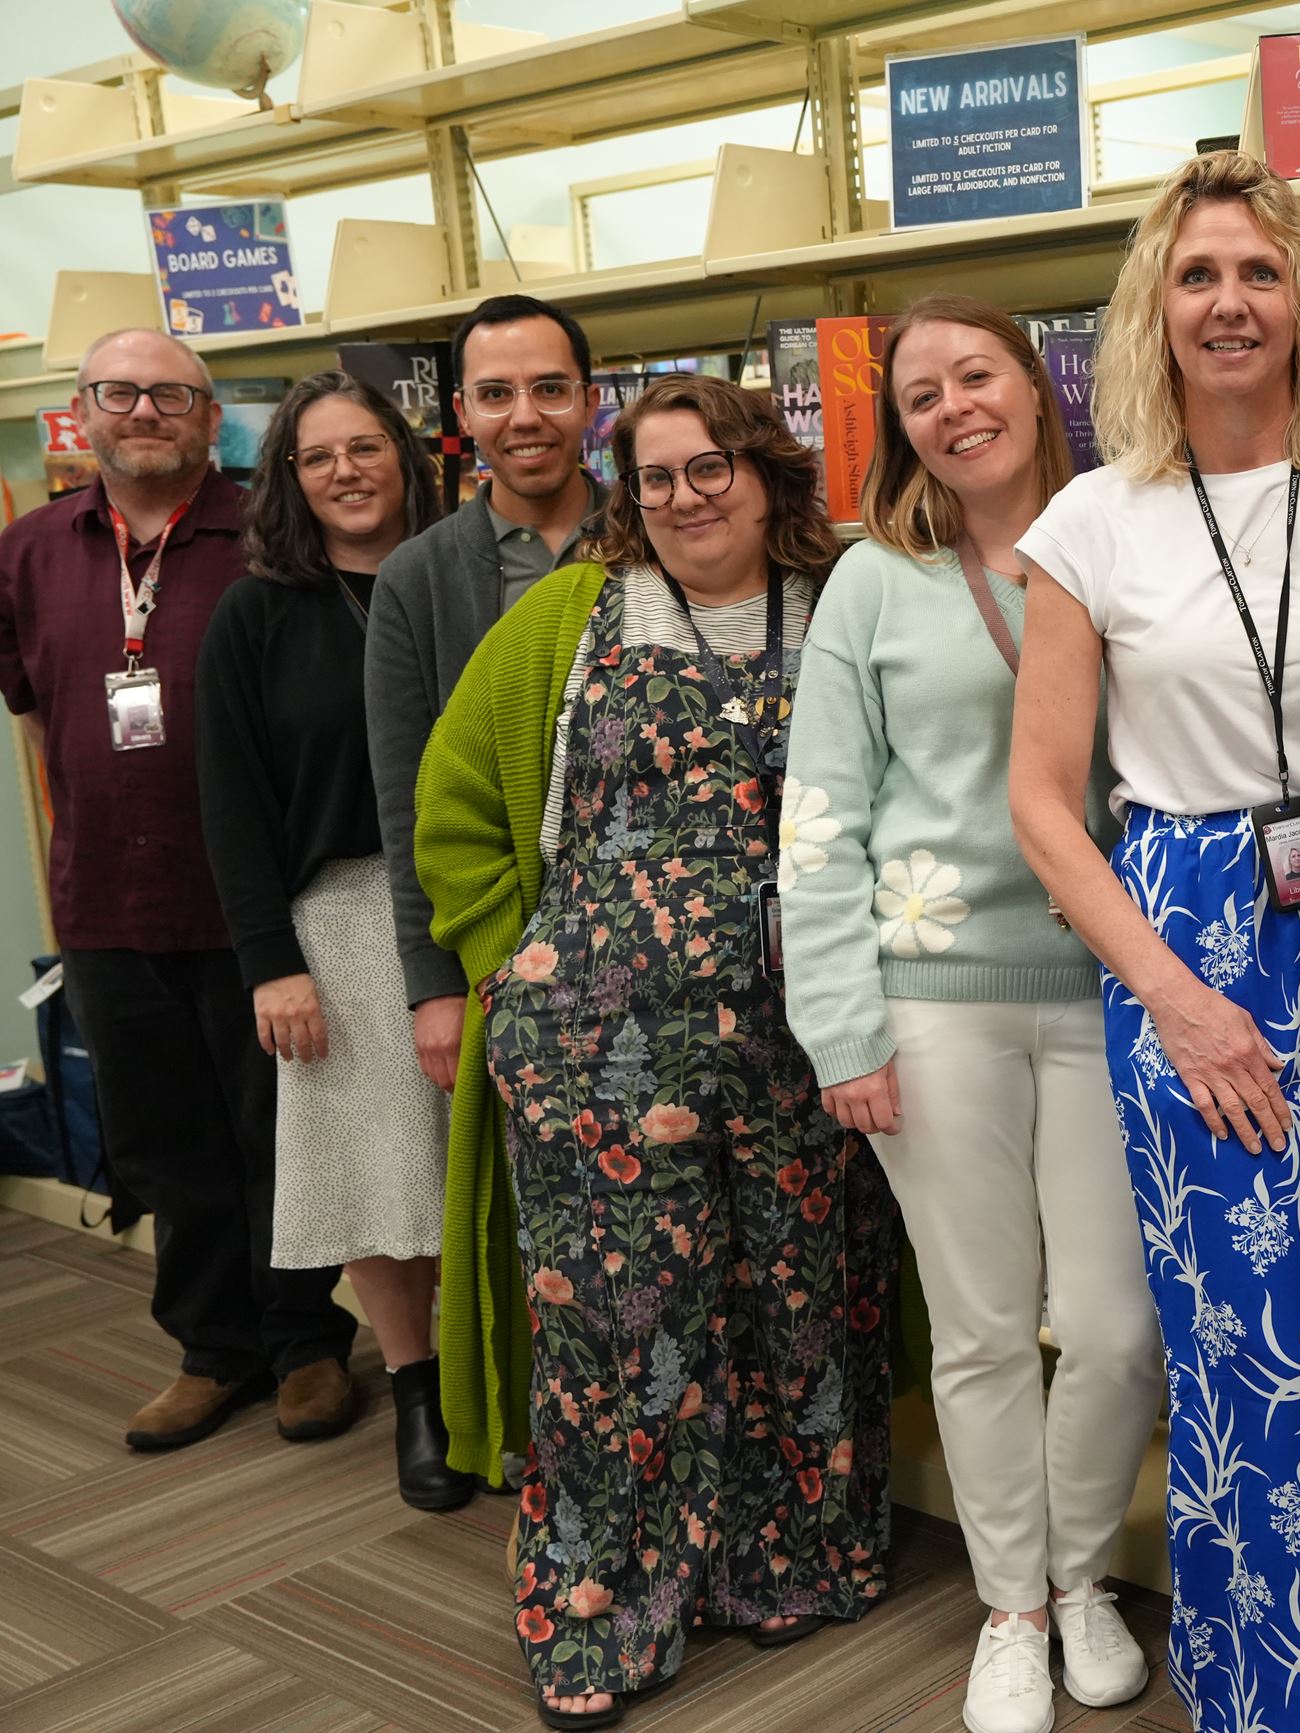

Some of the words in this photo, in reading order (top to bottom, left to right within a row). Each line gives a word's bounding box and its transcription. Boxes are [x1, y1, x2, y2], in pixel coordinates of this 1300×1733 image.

[900, 85, 950, 116] NEW
[960, 71, 1067, 109] ARRIVALS
[912, 136, 940, 149] LIMITED
[940, 136, 951, 146] TO
[953, 135, 960, 146] 5
[960, 131, 1004, 144] CHECKOUTS
[1005, 129, 1019, 140] PER
[1020, 126, 1041, 137] CARD
[1042, 124, 1058, 134] FOR
[958, 144, 980, 156] ADULT
[982, 142, 1012, 154] FICTION
[908, 184, 932, 196] LARGE
[934, 183, 955, 193] PRINT,
[956, 180, 1001, 192] AUDIOBOOK,
[1003, 176, 1018, 187] AND
[1020, 172, 1065, 185] NONFICTION
[912, 172, 938, 184] LIMITED
[940, 172, 950, 182] TO
[952, 171, 962, 182] 10
[963, 166, 1006, 180] CHECKOUTS
[1008, 164, 1021, 175] PER
[1022, 162, 1044, 172] CARD
[1045, 160, 1060, 170] FOR
[167, 251, 218, 272] BOARD
[222, 246, 278, 268] GAMES
[832, 327, 887, 361] OU
[782, 383, 822, 408] HA
[1291, 474, 1299, 491] TOWN
[1196, 486, 1209, 513] CLAYTON
[1288, 498, 1296, 524] CLAYTON
[1206, 518, 1218, 538] TOWN
[1222, 558, 1236, 586] CLAYTON
[1234, 592, 1247, 612] TOWN
[1252, 636, 1265, 667] CLAYTON
[1264, 676, 1276, 696] TOWN
